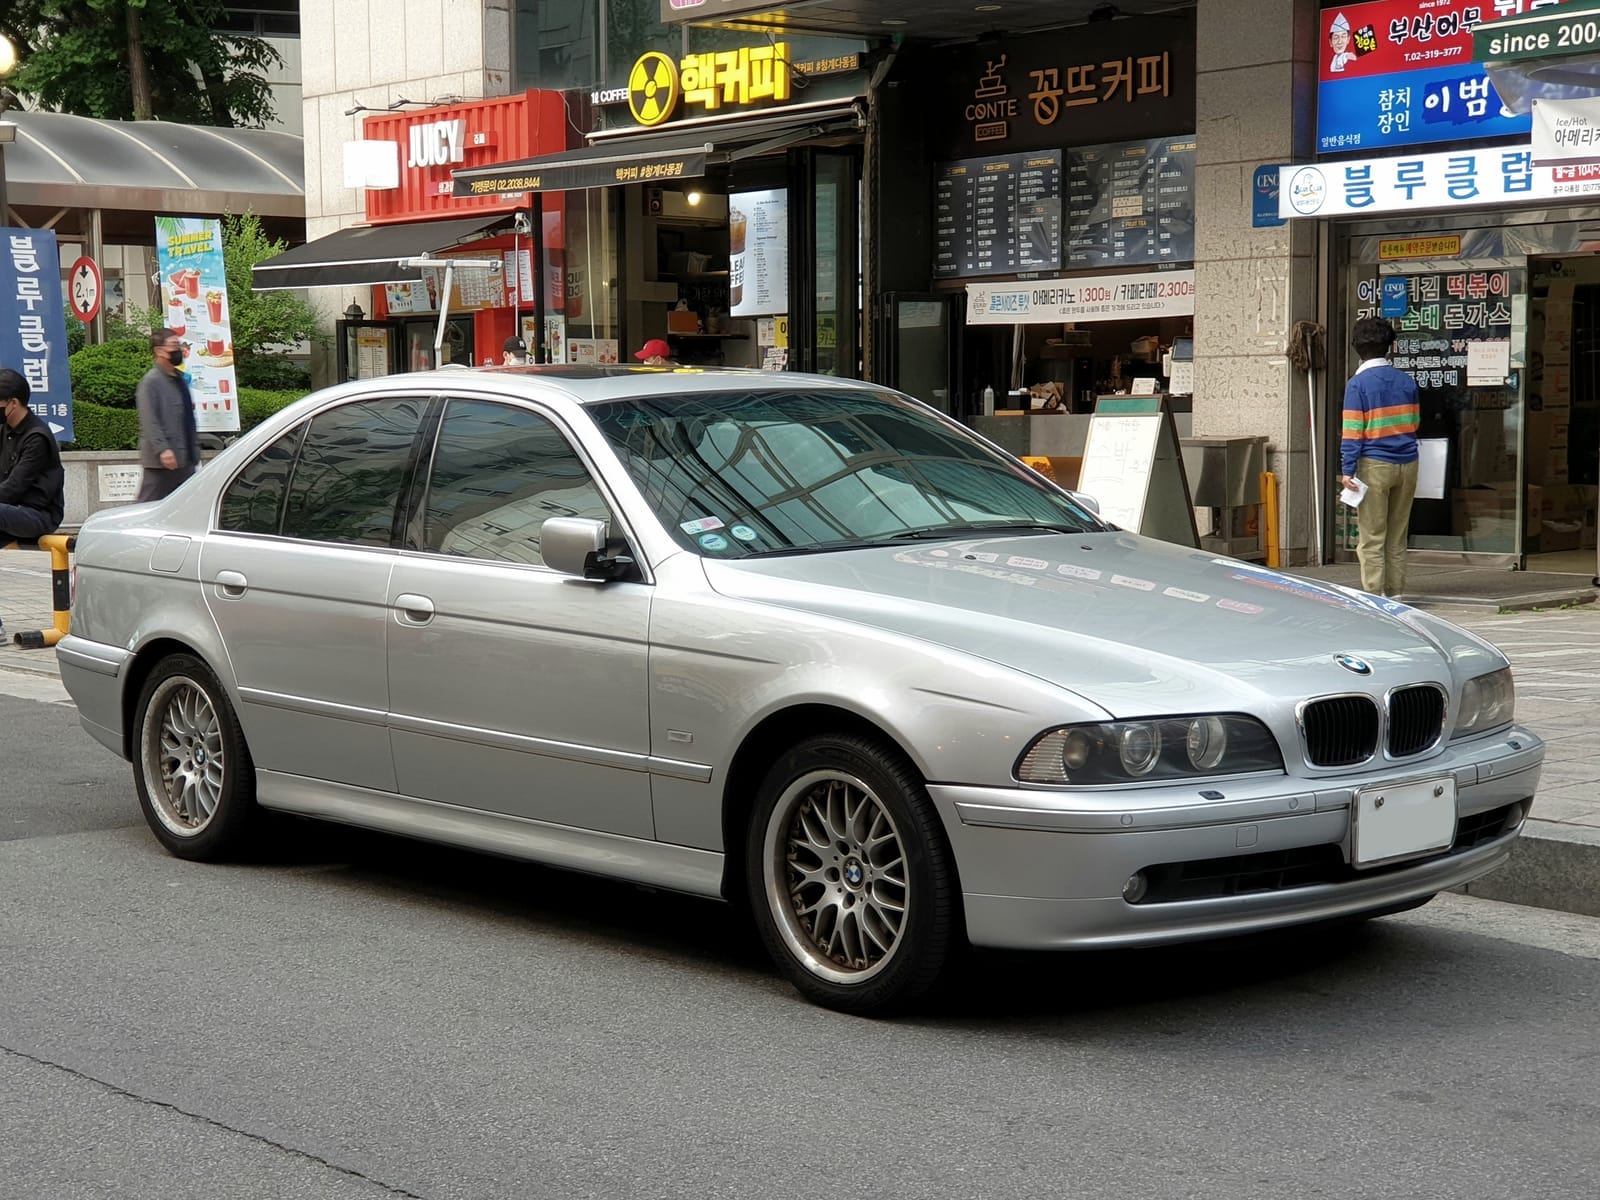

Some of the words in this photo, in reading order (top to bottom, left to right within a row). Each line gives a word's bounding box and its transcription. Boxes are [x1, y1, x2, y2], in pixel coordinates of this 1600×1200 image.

[1404, 46, 1463, 62] T.02-319-3777
[1489, 33, 1550, 55] since
[680, 42, 791, 110] 핵커피
[1378, 87, 1411, 111] 참치
[1424, 76, 1520, 118] 이범
[965, 99, 1018, 120] CONTE
[977, 126, 1005, 137] COFFEE
[1377, 110, 1410, 134] 장인
[1556, 117, 1588, 127] Ice/Hot
[408, 119, 466, 168] JUICY
[1321, 133, 1362, 148] 일반음식점
[1343, 151, 1533, 208] 블루클럽
[168, 231, 214, 247] SUMMER
[168, 243, 216, 258] TRAVEL
[75, 282, 95, 299] 2.1m
[1033, 288, 1076, 305] 아메리카노
[1446, 271, 1510, 300] 떡볶이
[10, 235, 50, 393] 블루클럽
[1400, 304, 1440, 331] 순대
[1444, 302, 1511, 330] 돈까스
